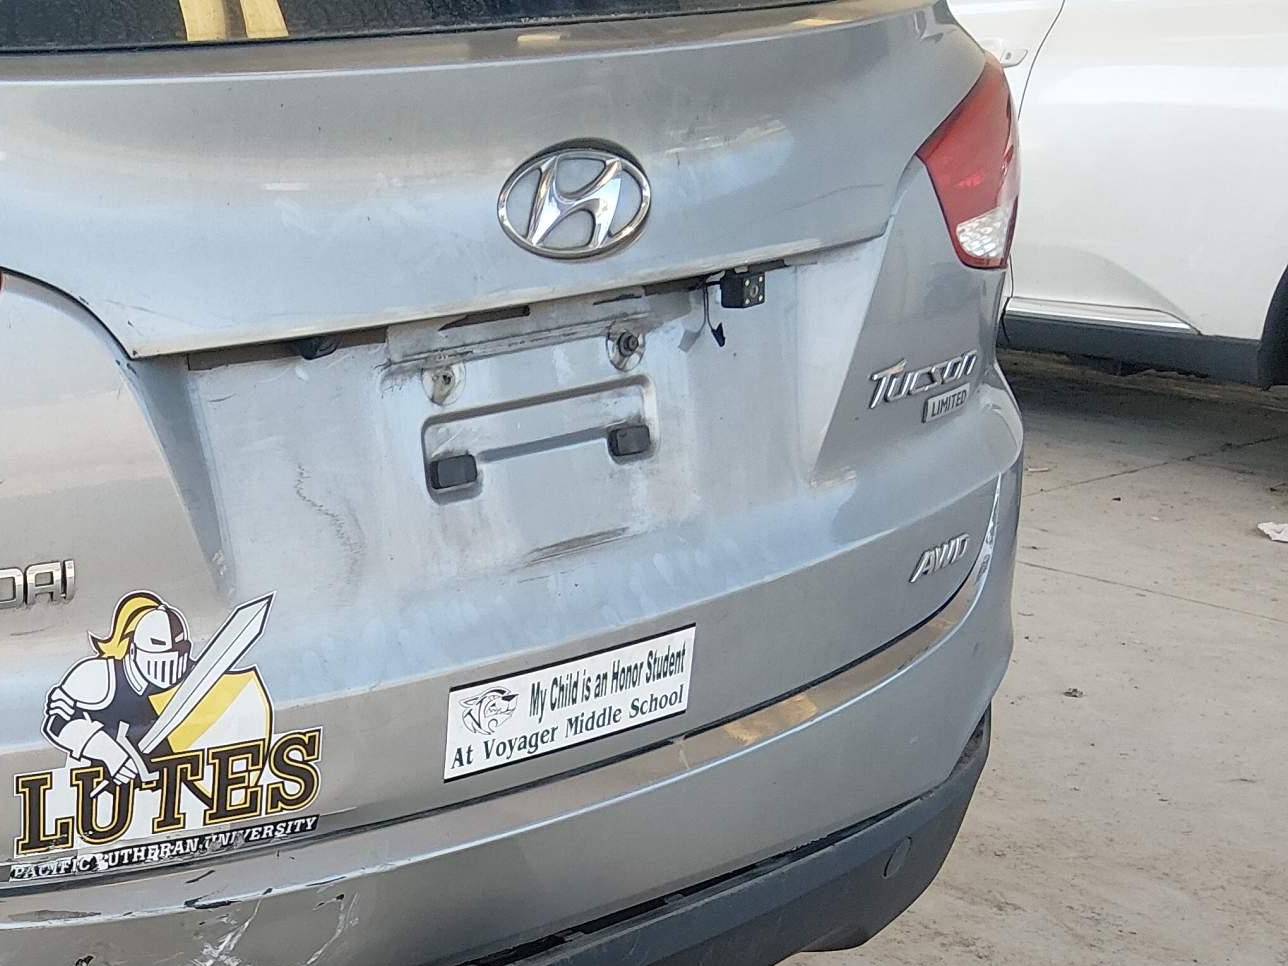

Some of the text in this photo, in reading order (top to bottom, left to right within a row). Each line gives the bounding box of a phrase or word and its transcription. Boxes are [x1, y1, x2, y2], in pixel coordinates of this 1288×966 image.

[930, 389, 967, 418] LIMITED
[909, 533, 970, 583] AWD
[529, 642, 686, 724] My Child is an Honor Student
[450, 685, 684, 769] At Voyager Middle School
[14, 728, 322, 856] LUTES
